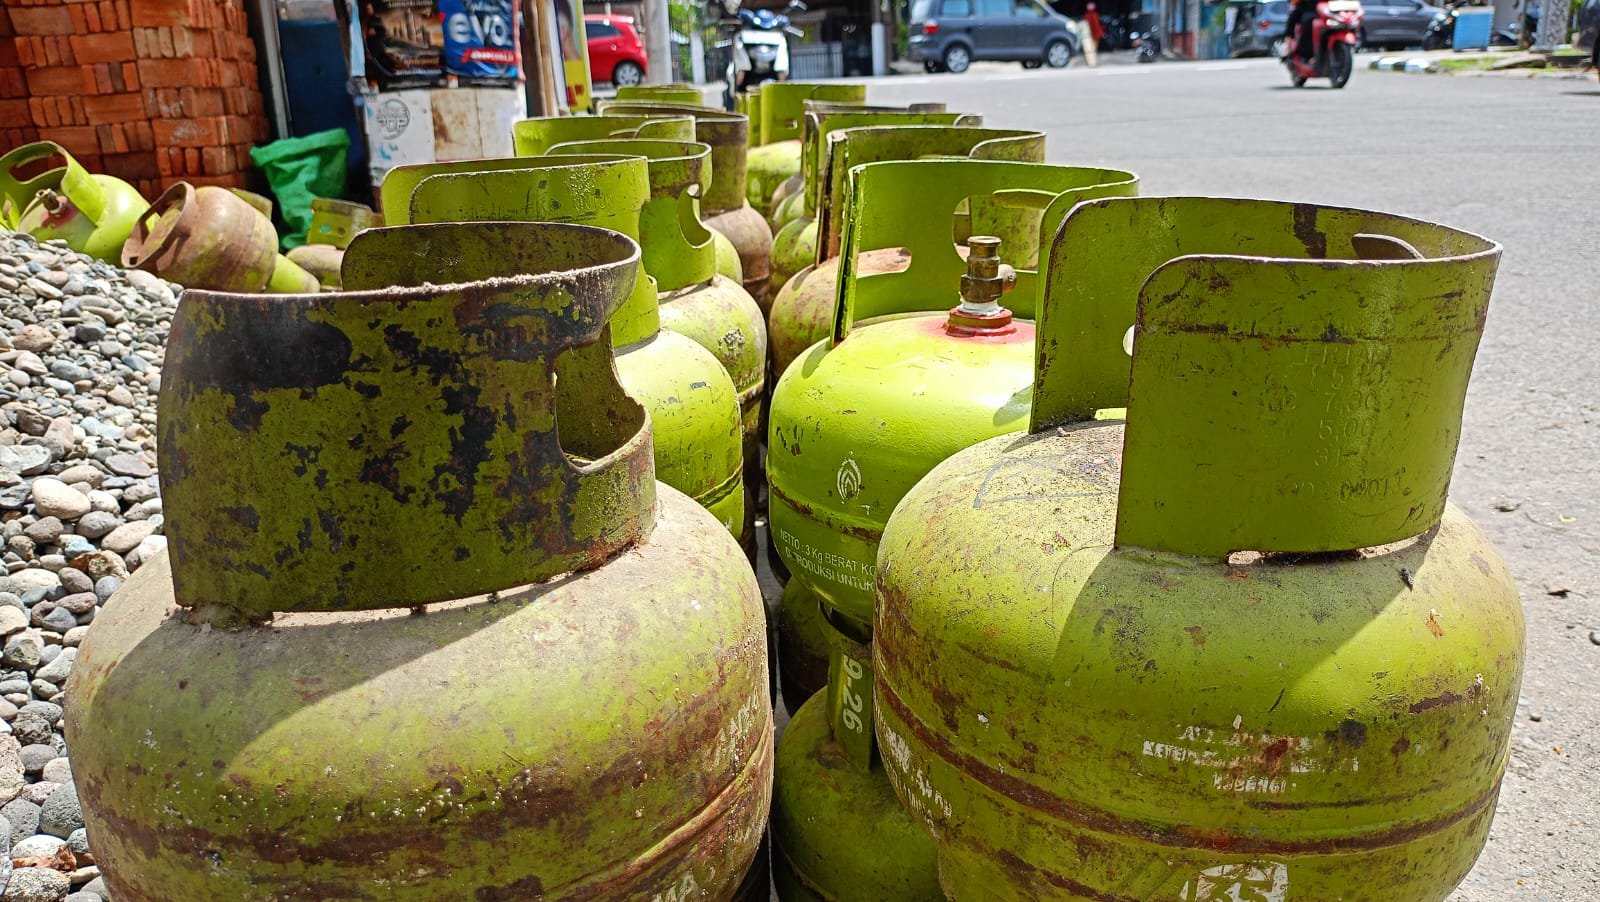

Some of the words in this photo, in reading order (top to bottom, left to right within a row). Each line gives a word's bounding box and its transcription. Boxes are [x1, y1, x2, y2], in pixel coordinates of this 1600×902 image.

[448, 12, 508, 46] evo
[805, 544, 811, 556] 3
[812, 548, 823, 564] Kg
[825, 552, 858, 571] BERAT
[837, 571, 874, 592] UNTUK
[842, 654, 863, 734] 9-26
